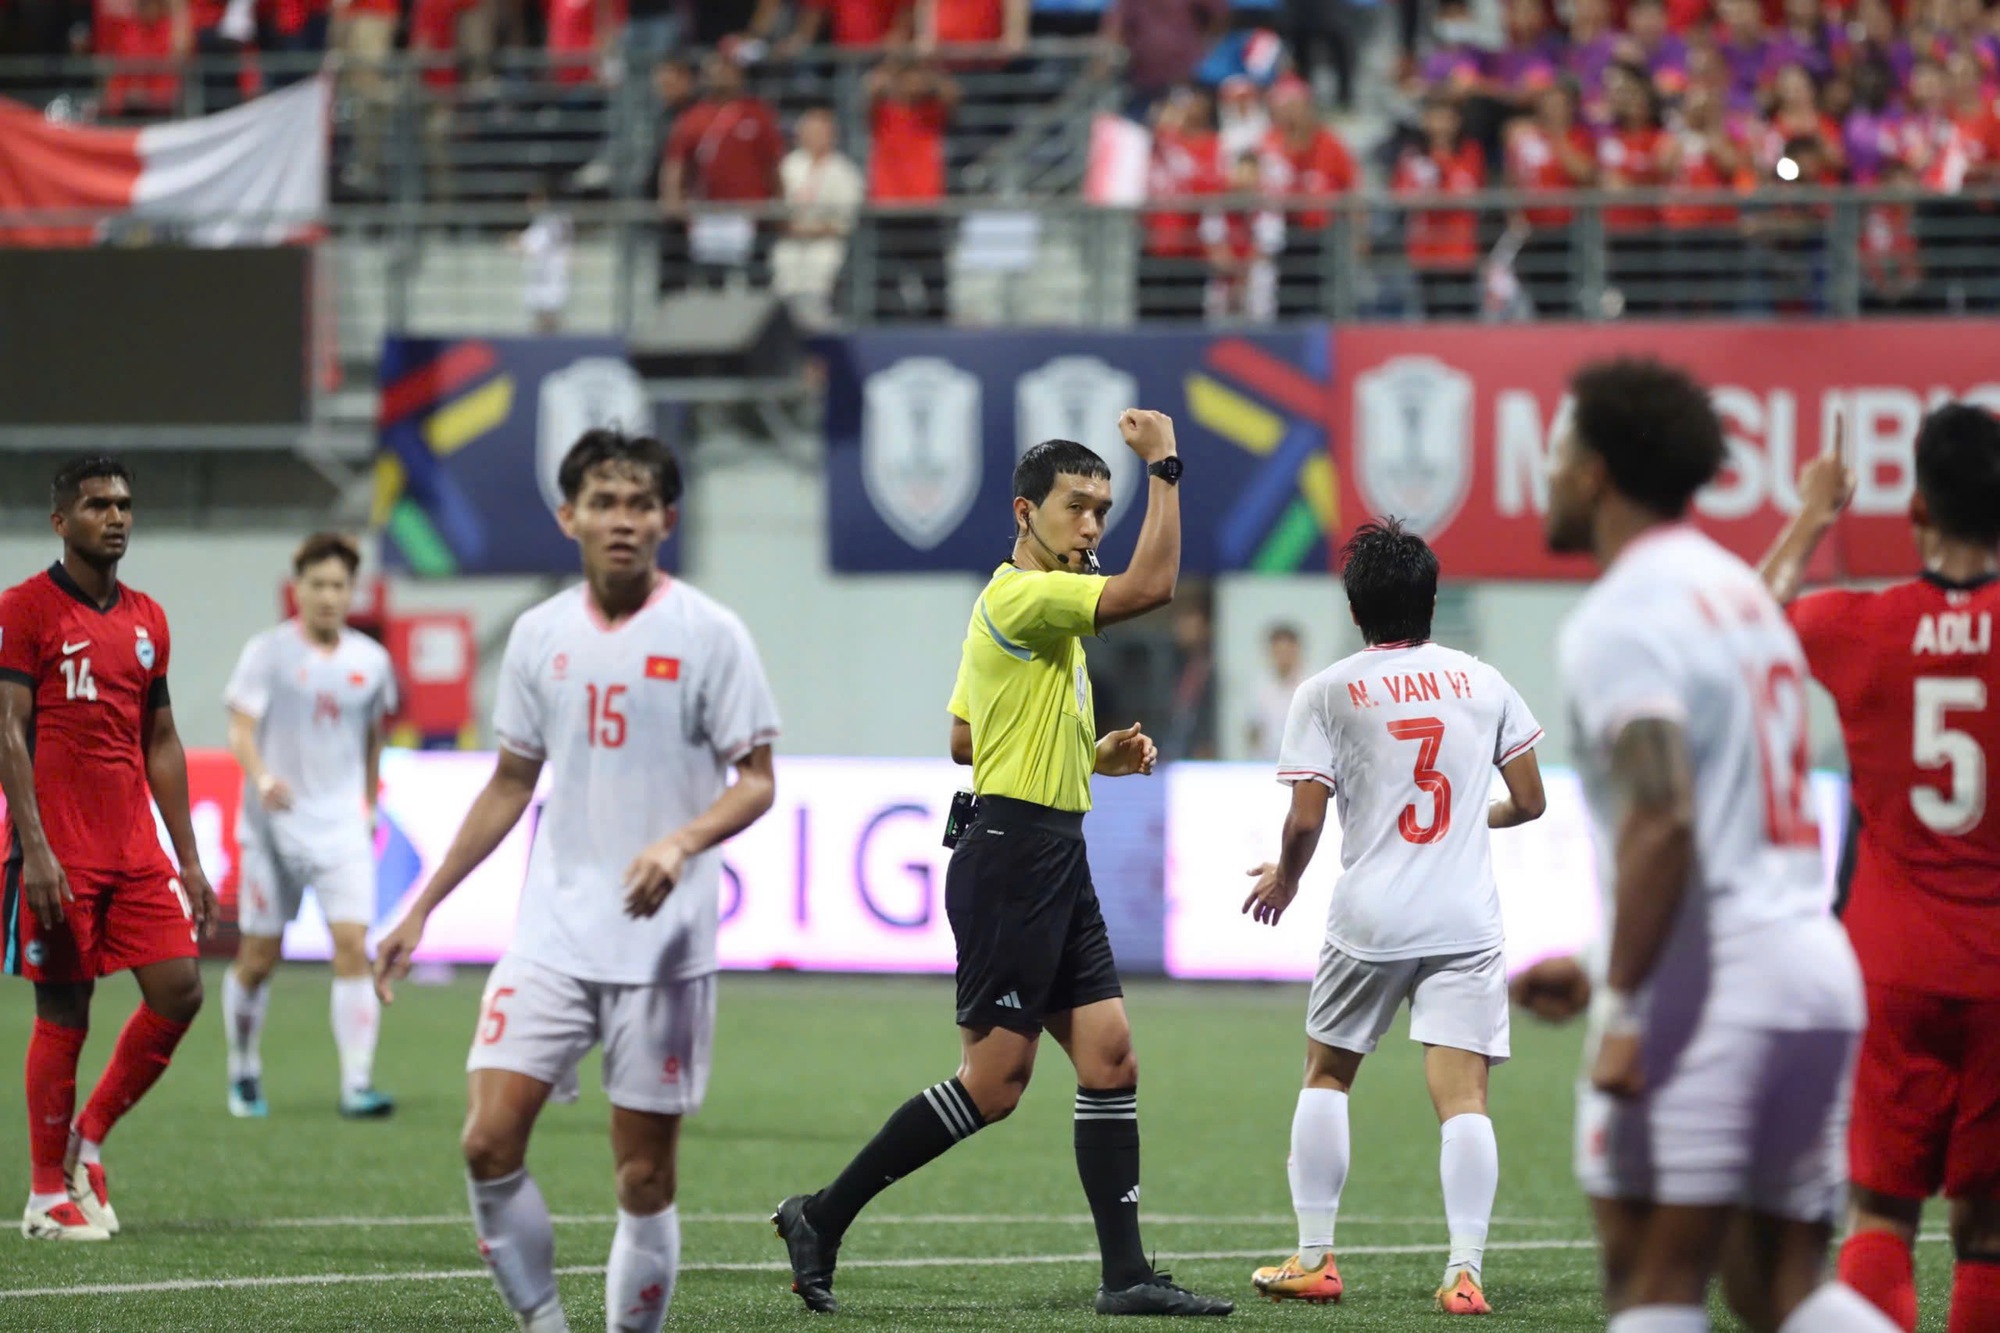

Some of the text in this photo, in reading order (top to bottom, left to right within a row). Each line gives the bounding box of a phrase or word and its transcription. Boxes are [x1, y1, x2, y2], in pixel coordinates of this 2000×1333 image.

[1495, 385, 2000, 517] MSUB
[60, 657, 97, 701] 14
[586, 683, 628, 748] 15
[1382, 672, 1441, 703] VAN
[1444, 670, 1472, 698] VI
[1386, 716, 1451, 845] 3
[1911, 676, 1987, 836] 5
